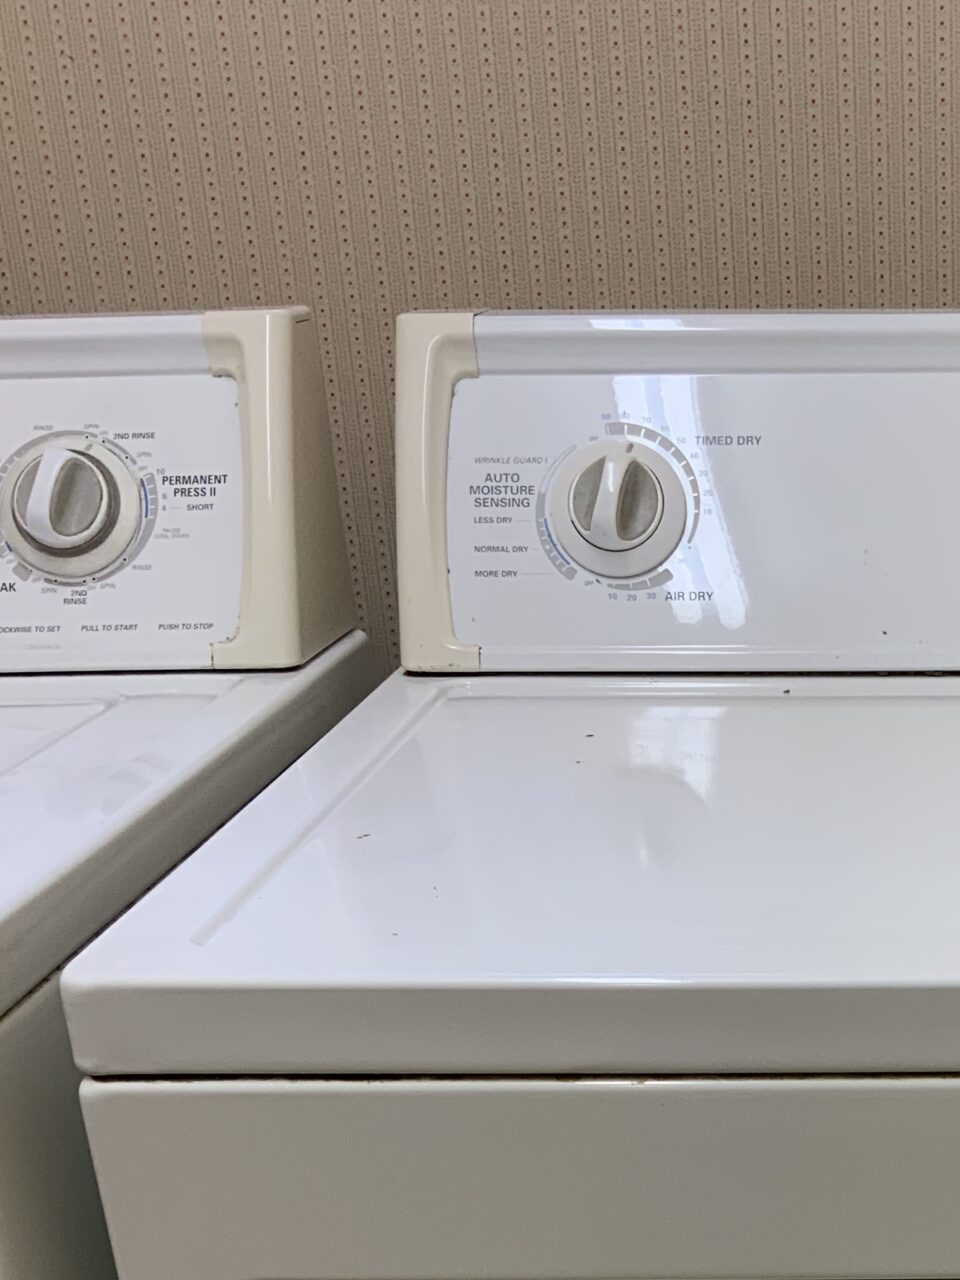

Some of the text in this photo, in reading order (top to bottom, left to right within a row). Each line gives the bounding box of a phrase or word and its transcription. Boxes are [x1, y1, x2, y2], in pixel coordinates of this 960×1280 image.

[113, 432, 130, 440] 2ND
[131, 431, 156, 440] RINSE
[694, 435, 762, 446] TIMED DRY
[162, 475, 228, 485] PERMANENT
[484, 473, 520, 483] AUTO
[173, 487, 217, 497] PRESS II
[469, 485, 535, 496] MOISTURE
[473, 497, 531, 508] SENSING
[473, 516, 513, 524] LESS DRY
[473, 545, 529, 553] NORMAL DRY
[474, 570, 518, 578] MORE DRY
[627, 594, 637, 602] 20
[646, 592, 656, 600] 30
[665, 591, 714, 601] AIR DRY
[81, 623, 138, 632] PULL TO START
[158, 622, 214, 631] PUSH TO STOP
